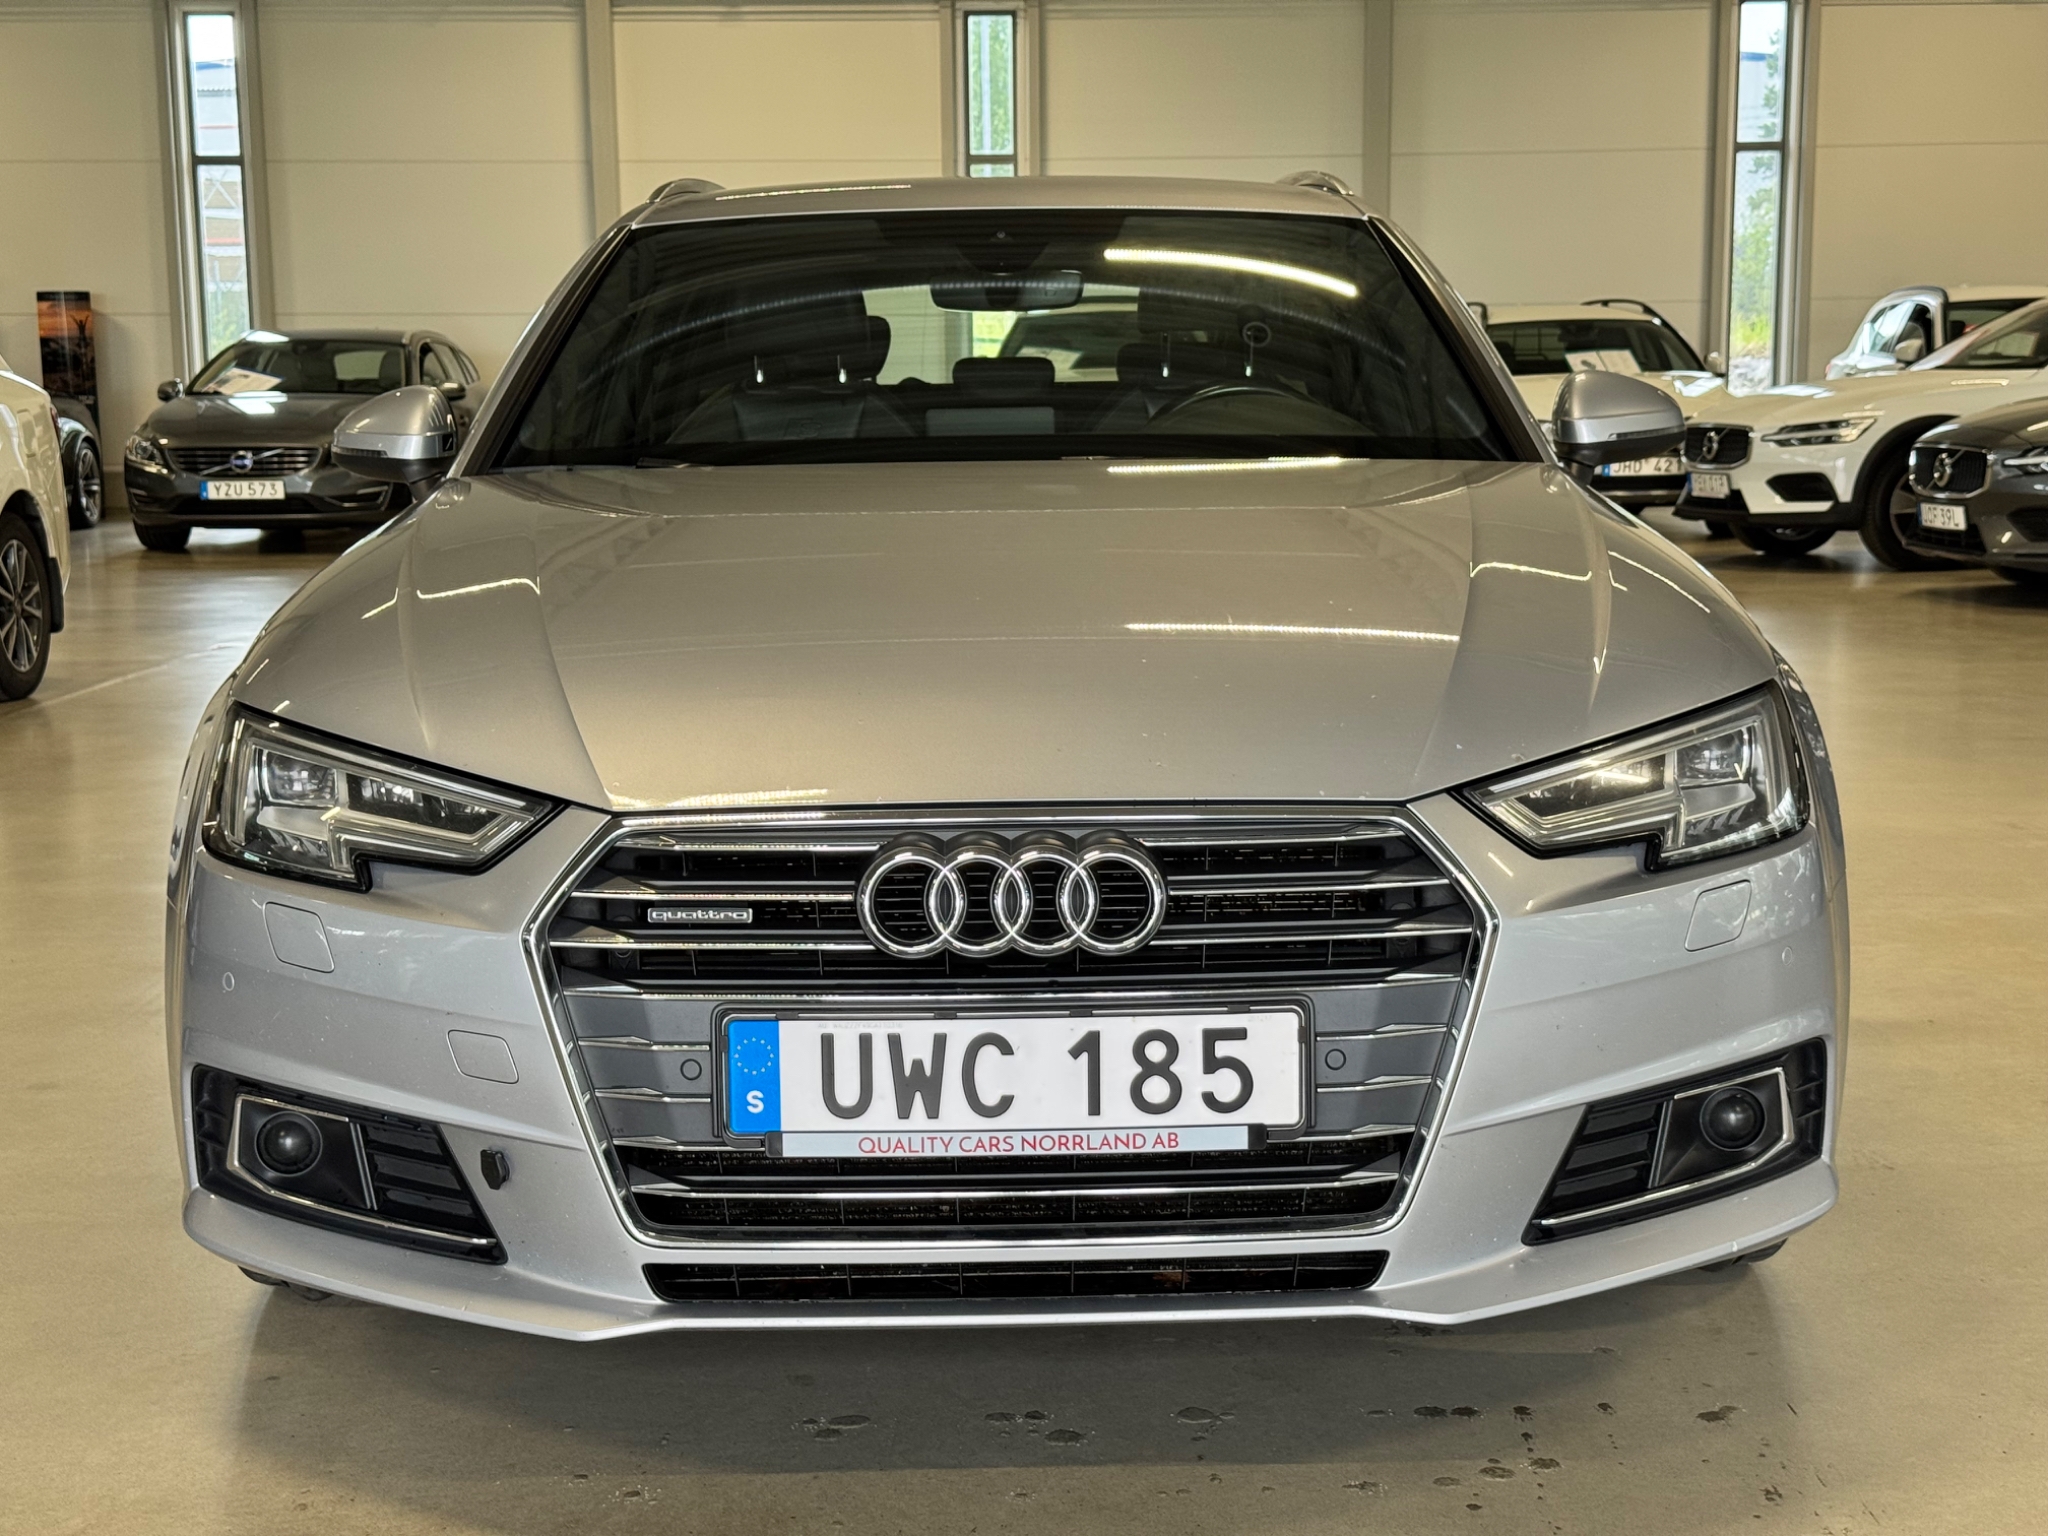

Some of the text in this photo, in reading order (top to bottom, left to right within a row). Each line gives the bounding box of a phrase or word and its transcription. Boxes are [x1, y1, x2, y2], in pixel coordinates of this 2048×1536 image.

[213, 482, 278, 497] YZU 573
[652, 909, 748, 921] quattro
[820, 1026, 1255, 1120] UWC 185
[746, 1090, 764, 1114] S
[858, 1132, 1179, 1154] QUALITY CARS NORRLAND AB
